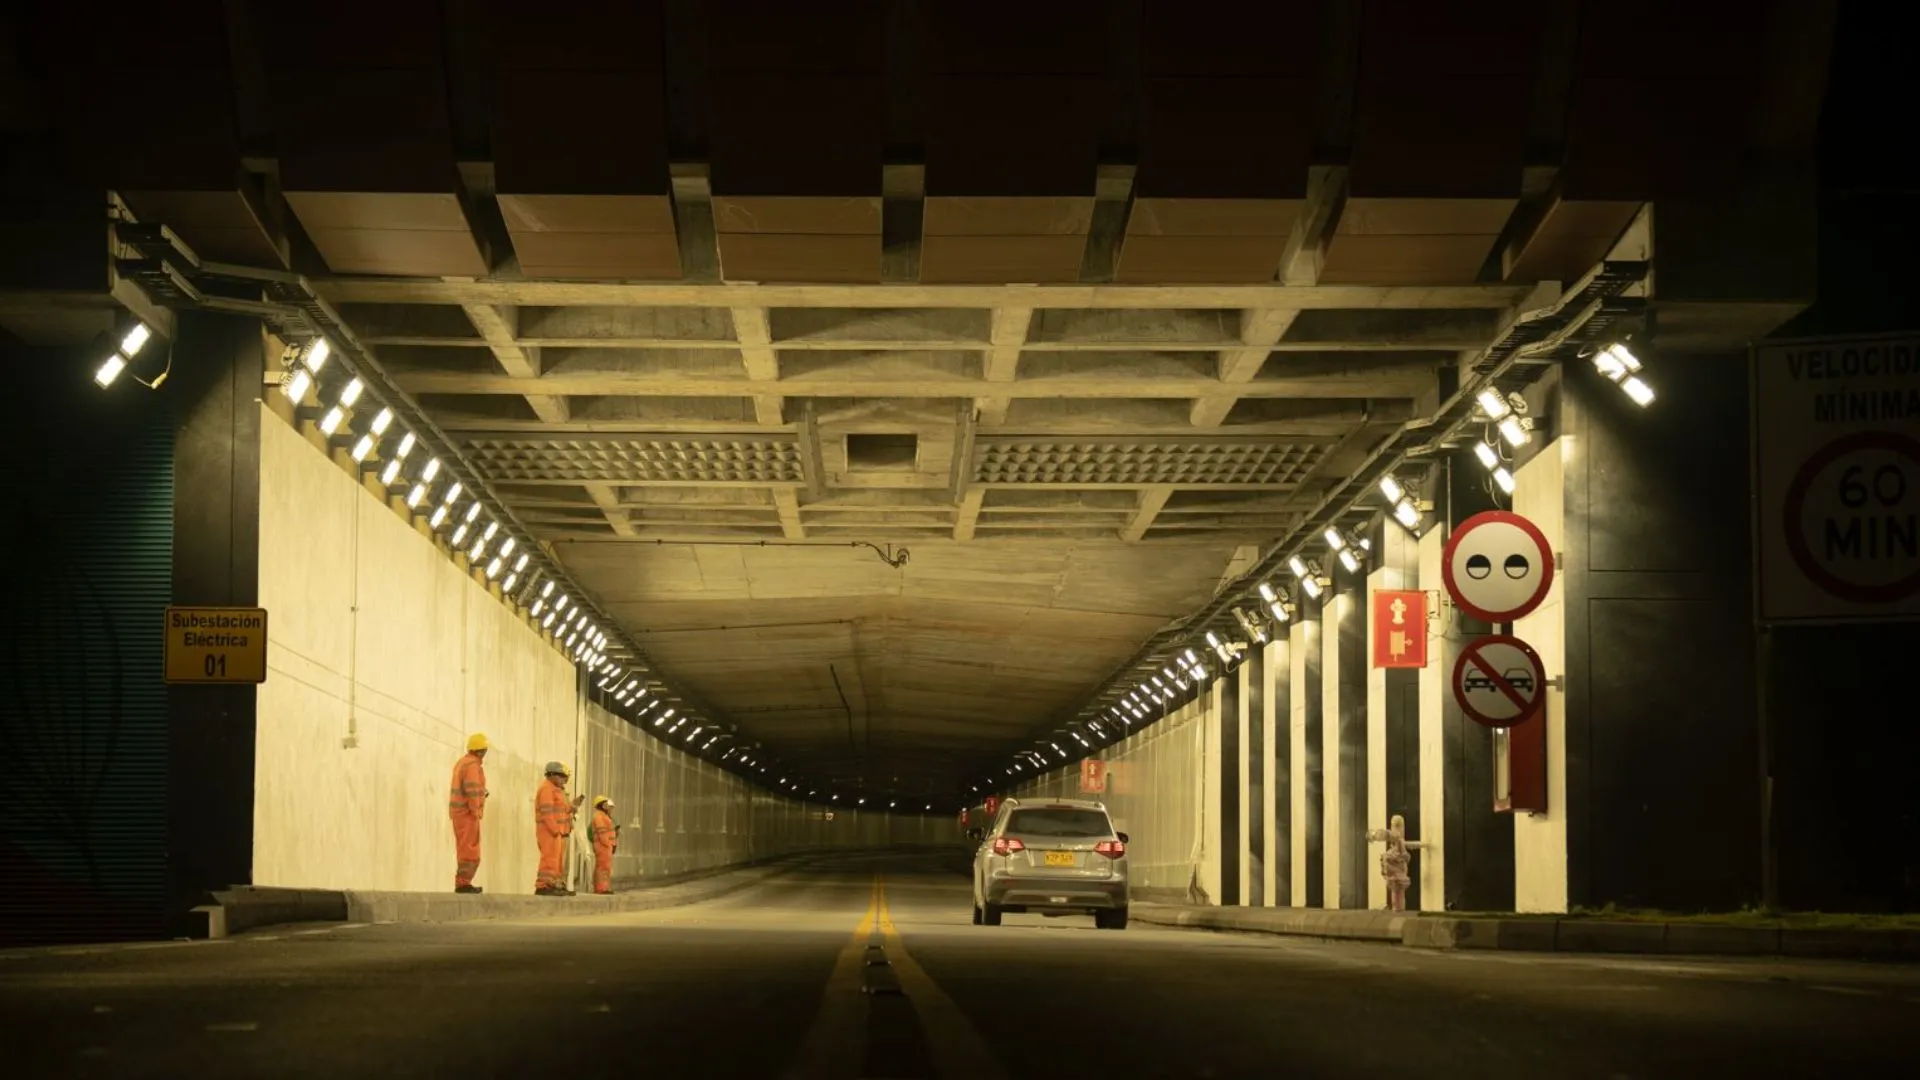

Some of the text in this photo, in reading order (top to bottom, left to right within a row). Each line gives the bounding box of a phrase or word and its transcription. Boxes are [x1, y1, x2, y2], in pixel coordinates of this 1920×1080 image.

[1839, 465, 1905, 508] 60
[1825, 515, 1917, 560] MIN
[172, 613, 260, 628] Subestación
[184, 632, 248, 647] Eléctrica
[205, 654, 226, 676] 01
